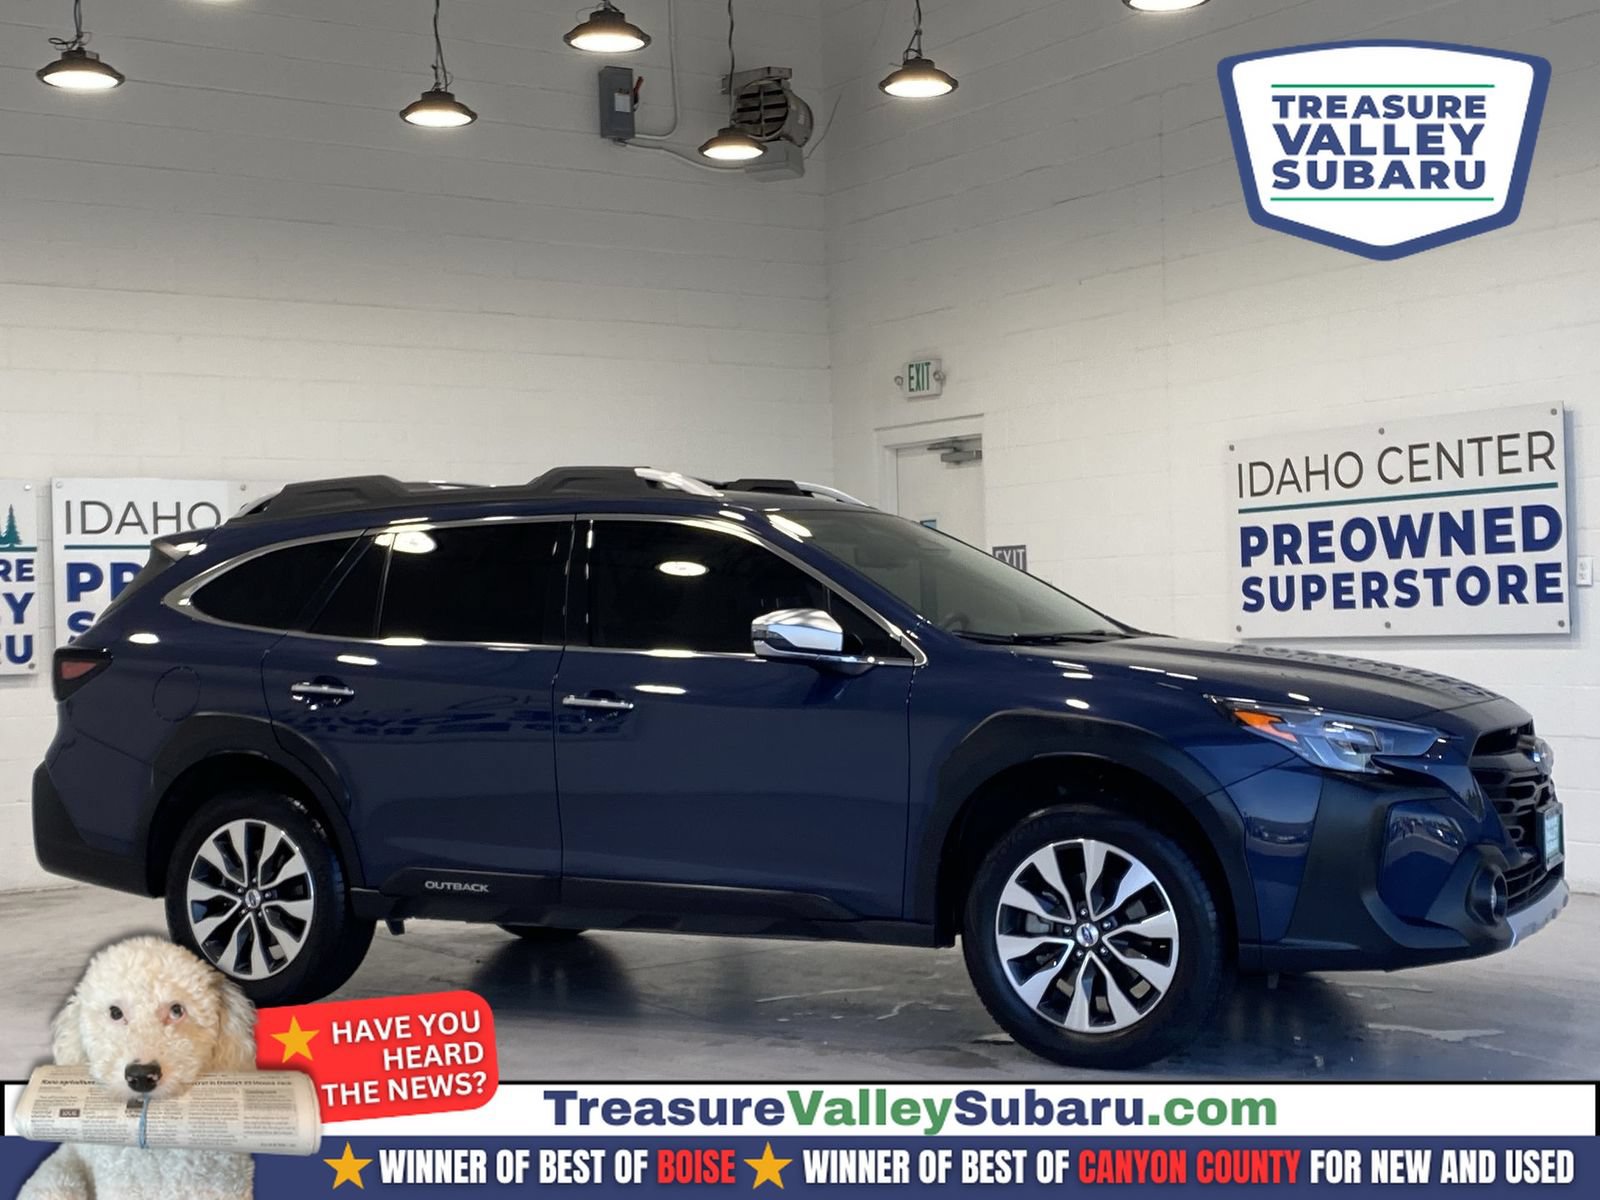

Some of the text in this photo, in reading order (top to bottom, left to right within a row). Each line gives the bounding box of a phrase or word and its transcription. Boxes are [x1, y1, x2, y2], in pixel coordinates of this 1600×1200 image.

[908, 362, 931, 392] EXIT
[1237, 430, 1556, 499] IDAHO CENTER
[65, 500, 221, 535] IDAHO
[1240, 504, 1563, 568] PREOWNED
[1241, 562, 1564, 614] SUPERSTORE
[424, 880, 490, 892] OUTBACK
